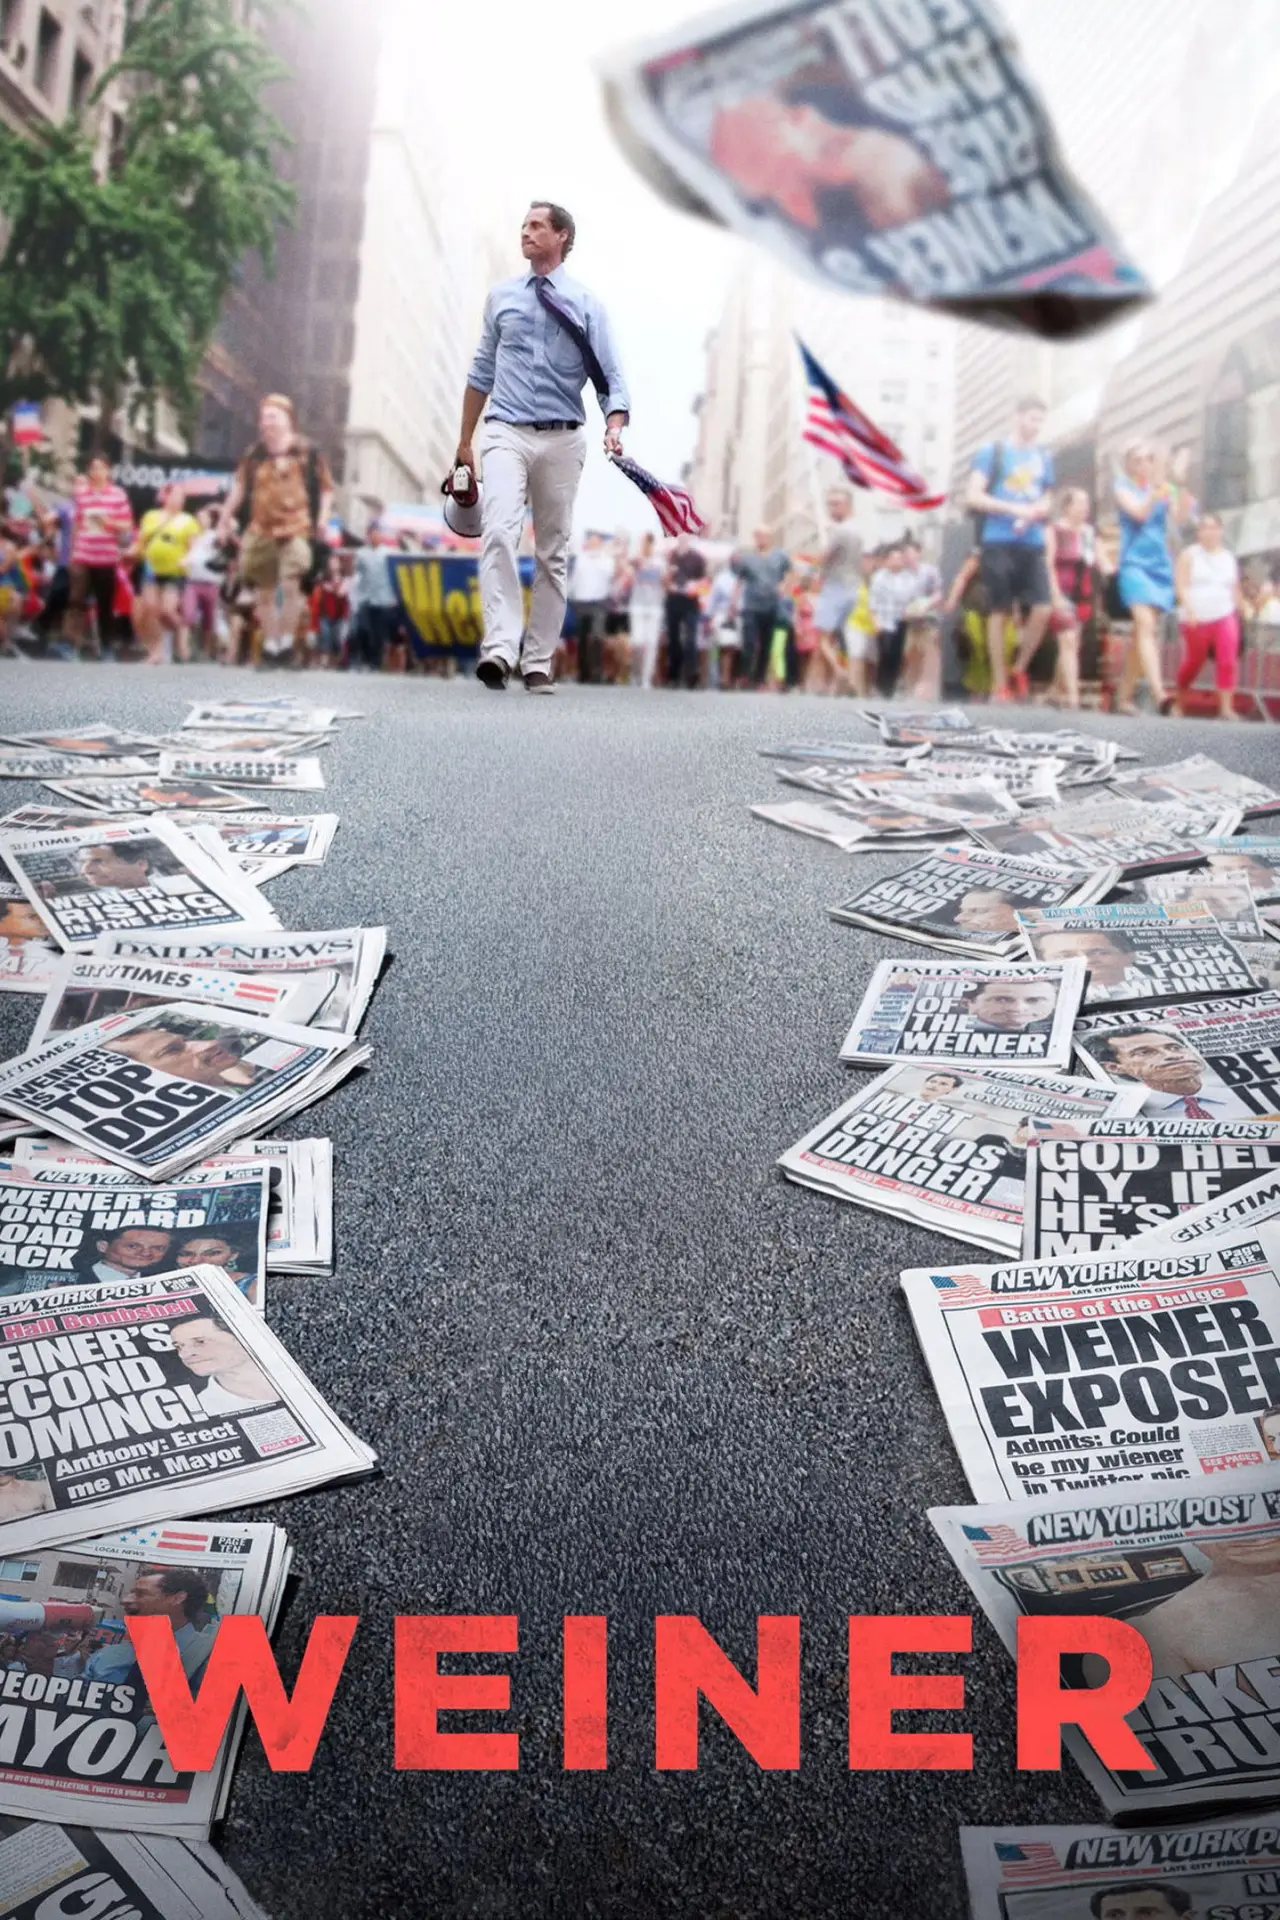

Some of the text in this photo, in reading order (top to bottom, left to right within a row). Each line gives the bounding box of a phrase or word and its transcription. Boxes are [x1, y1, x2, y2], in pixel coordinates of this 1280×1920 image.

[896, 869, 976, 901] RISE
[917, 857, 1075, 903] WEINER'S
[45, 886, 164, 911] WEINER
[54, 893, 223, 925] RISING
[870, 879, 948, 914] AND
[64, 924, 92, 935] IN
[96, 917, 147, 931] THE
[150, 906, 232, 924] POLLS
[112, 938, 354, 959] DAILY NEWS
[1134, 944, 1234, 966] STICK
[891, 966, 1064, 976] DAILY NEWS
[1123, 955, 1246, 981] A FORK
[922, 980, 978, 997] TIP
[1121, 974, 1253, 1000] WEINER
[915, 997, 962, 1013] OF
[1073, 990, 1280, 1031] DAILY NEWS
[911, 1013, 978, 1032] THE
[902, 1032, 1048, 1053] WEINER
[2, 1049, 109, 1099] WEINER
[23, 1055, 129, 1107] IS NYC'S
[1203, 1046, 1280, 1087] BE
[42, 1065, 156, 1123] TOP
[82, 1081, 215, 1150] DOG
[861, 1091, 976, 1134] MEET
[839, 1112, 1007, 1172] CARLOS
[1088, 1119, 1277, 1140] NEW YORK POST
[814, 1134, 993, 1202] DANGER
[1039, 1140, 1280, 1172] GOD HEL
[34, 1170, 91, 1184] NEW
[1040, 1170, 1222, 1204] N.Y. IF
[0, 1187, 178, 1212] WEINER'S
[0, 1205, 207, 1231] ONG HARD
[1039, 1200, 1173, 1235] HE'S
[0, 1223, 84, 1247] OAD
[0, 1243, 79, 1270] ACK
[1221, 1243, 1262, 1261] Page
[990, 1252, 1212, 1294] NEW YORK POST
[1094, 1285, 1113, 1293] CITY
[1114, 1283, 1141, 1291] FINAL
[0, 1298, 34, 1316] EW
[35, 1287, 98, 1311] YORK
[99, 1281, 156, 1303] POST
[999, 1287, 1226, 1325] Battle of the bulge
[3, 1298, 199, 1341] Hall Bombshell
[0, 1322, 173, 1383] EINER'S
[981, 1299, 1274, 1379] WEINER
[0, 1356, 167, 1420] COND
[979, 1349, 1280, 1438] EXPOSE
[0, 1384, 209, 1468] OMING!
[1006, 1433, 1103, 1456] Admits:
[1110, 1426, 1181, 1446] Could
[56, 1433, 169, 1477] Anthony:
[175, 1422, 239, 1449] Erect
[1012, 1447, 1185, 1477] be my wiener
[67, 1443, 243, 1500] me Mr. Mayor
[1022, 1480, 1048, 1496] in
[1027, 1508, 1100, 1546] NEW
[1099, 1498, 1181, 1538] YORK
[1181, 1493, 1256, 1527] POST
[121, 1549, 146, 1557] NEWS
[217, 1537, 247, 1547] PAGE
[219, 1544, 242, 1554] TEN
[1114, 1531, 1185, 1546] LATE CITY FINAL
[1122, 1656, 1280, 1731] AKE
[0, 1703, 180, 1784] AYOR
[1065, 1834, 1151, 1870] NEW
[1151, 1828, 1249, 1864] YORK
[1190, 1861, 1213, 1870] CITY
